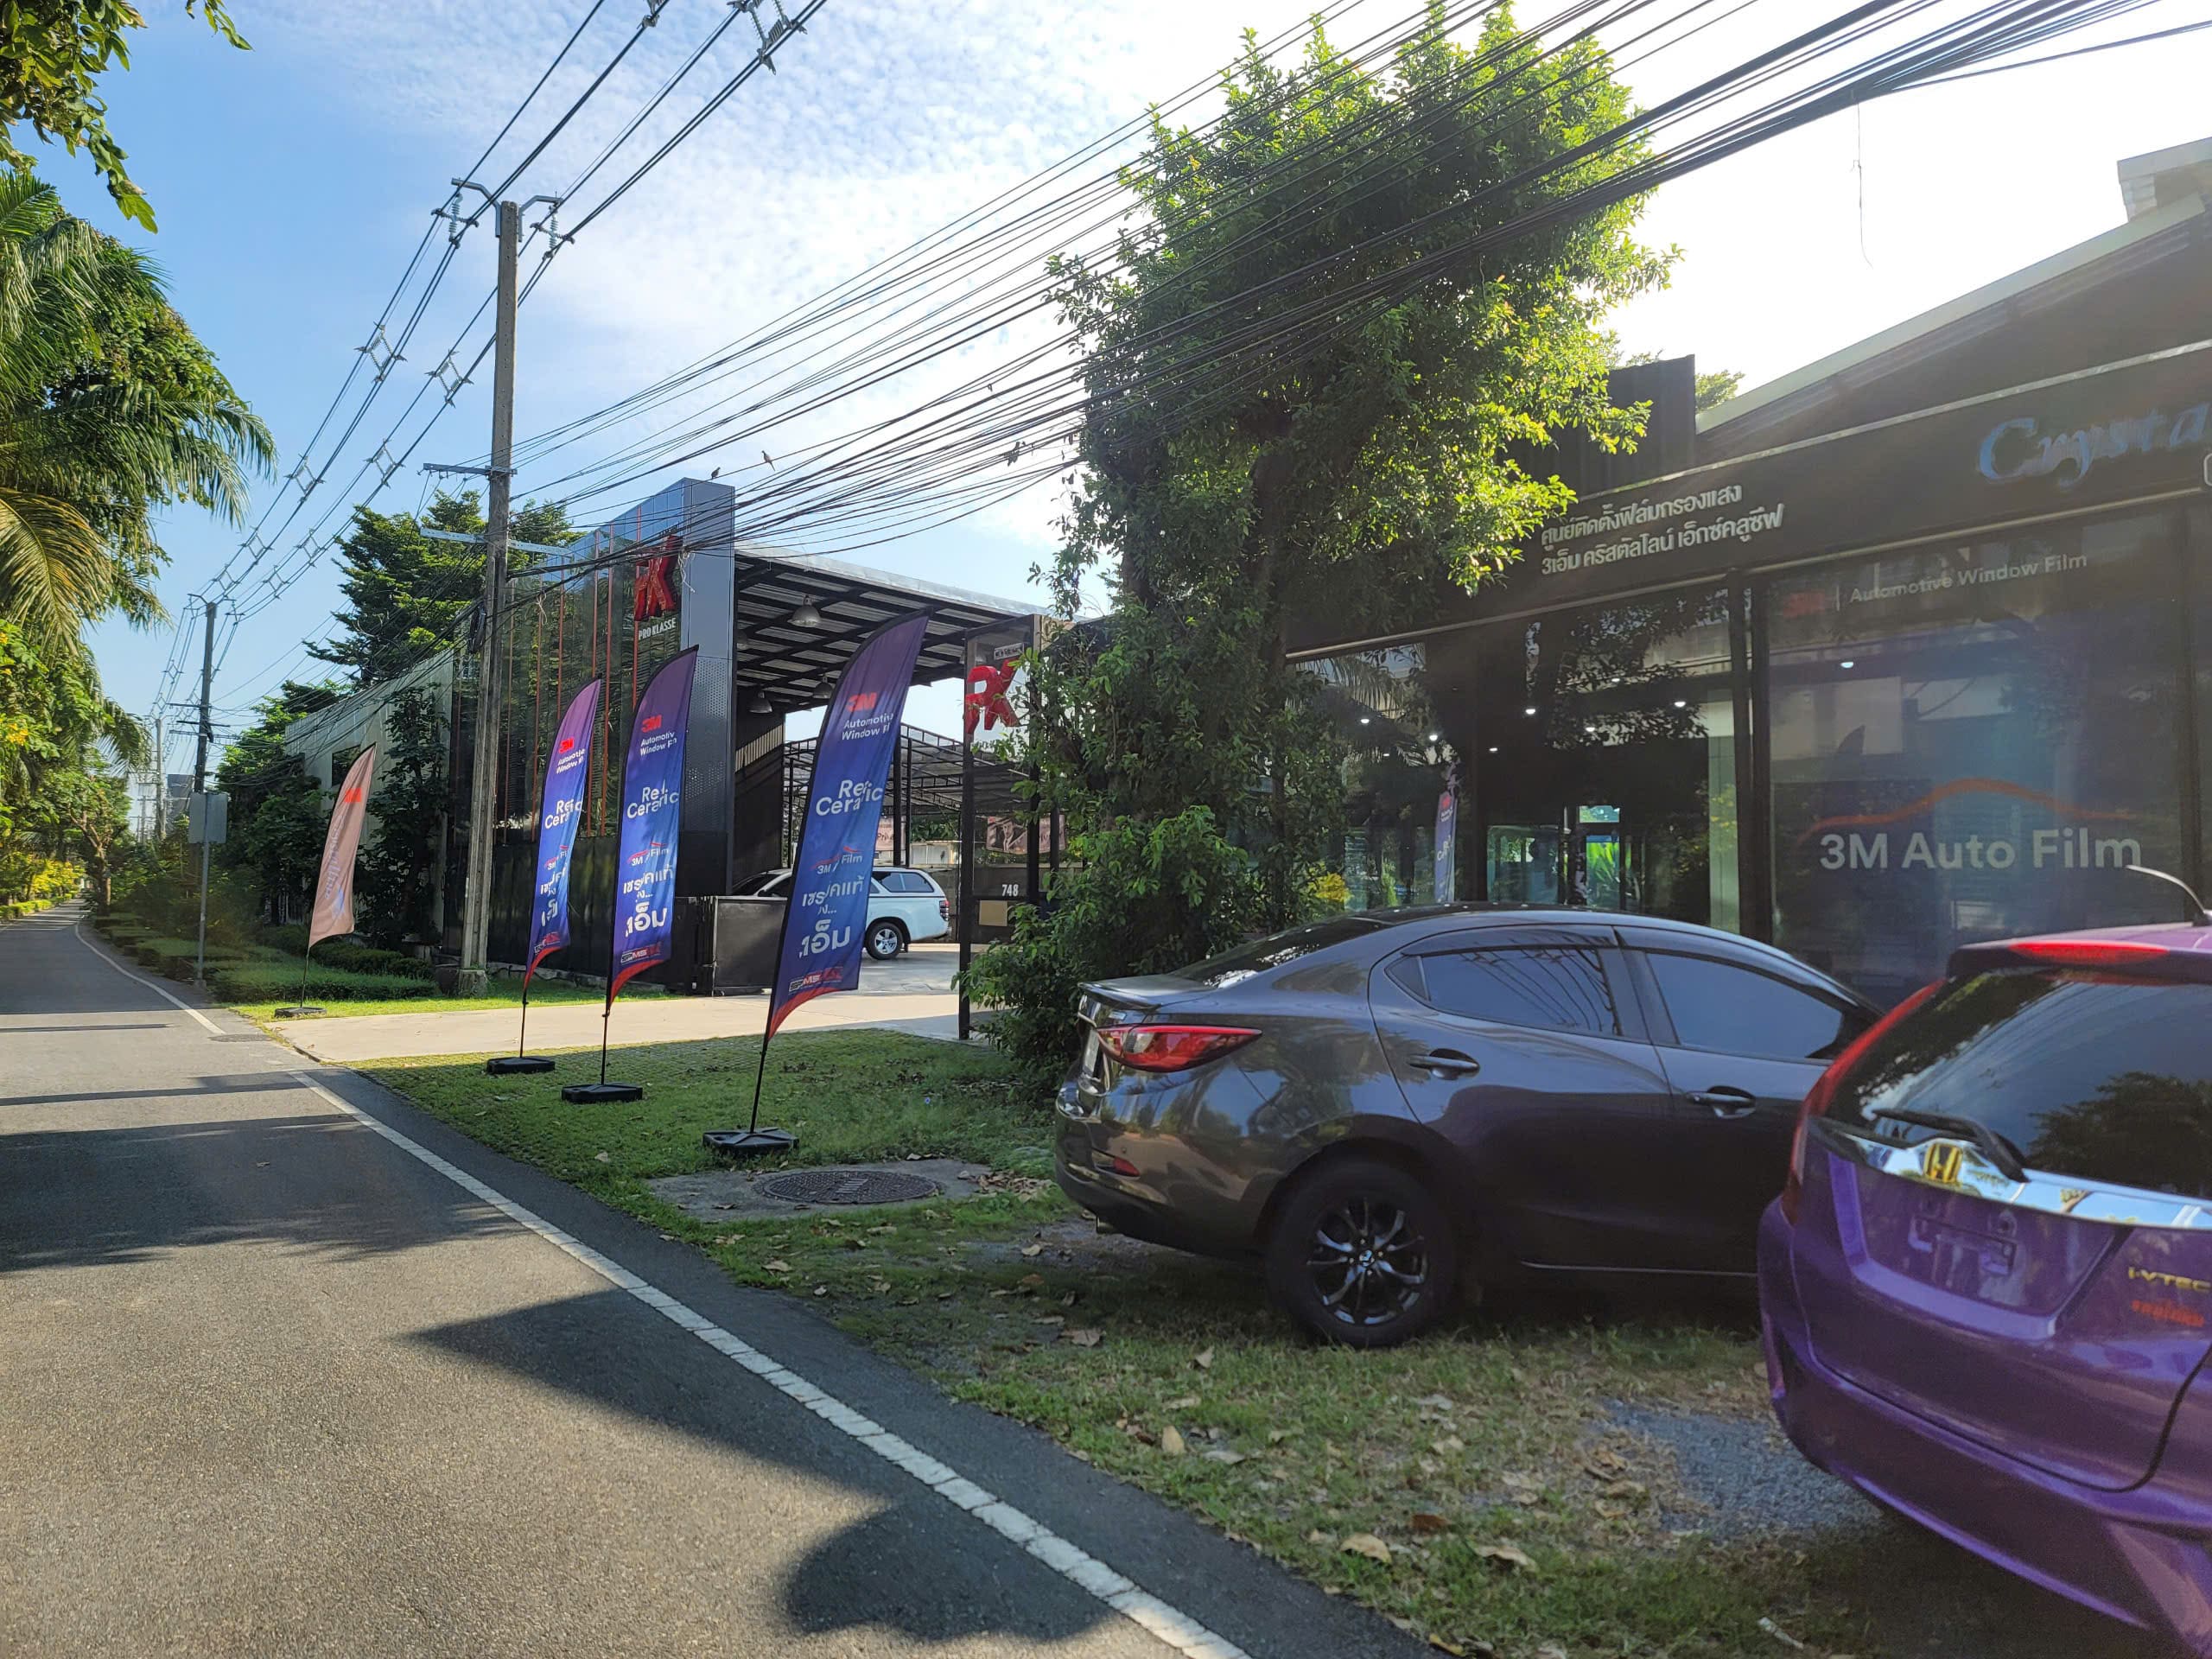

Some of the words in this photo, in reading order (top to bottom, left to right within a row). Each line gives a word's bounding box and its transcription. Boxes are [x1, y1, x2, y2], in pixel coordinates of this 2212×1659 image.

[1850, 576, 1953, 603] Automotive
[1957, 559, 2040, 586] Window
[2044, 554, 2088, 573] Film
[639, 626, 652, 640] PRO
[652, 617, 677, 636] KLASSE
[842, 728, 880, 741] Window
[1819, 833, 1888, 869] 3M
[1901, 831, 2016, 869] Auto
[2032, 827, 2141, 868] Film
[1001, 884, 1019, 897] 748
